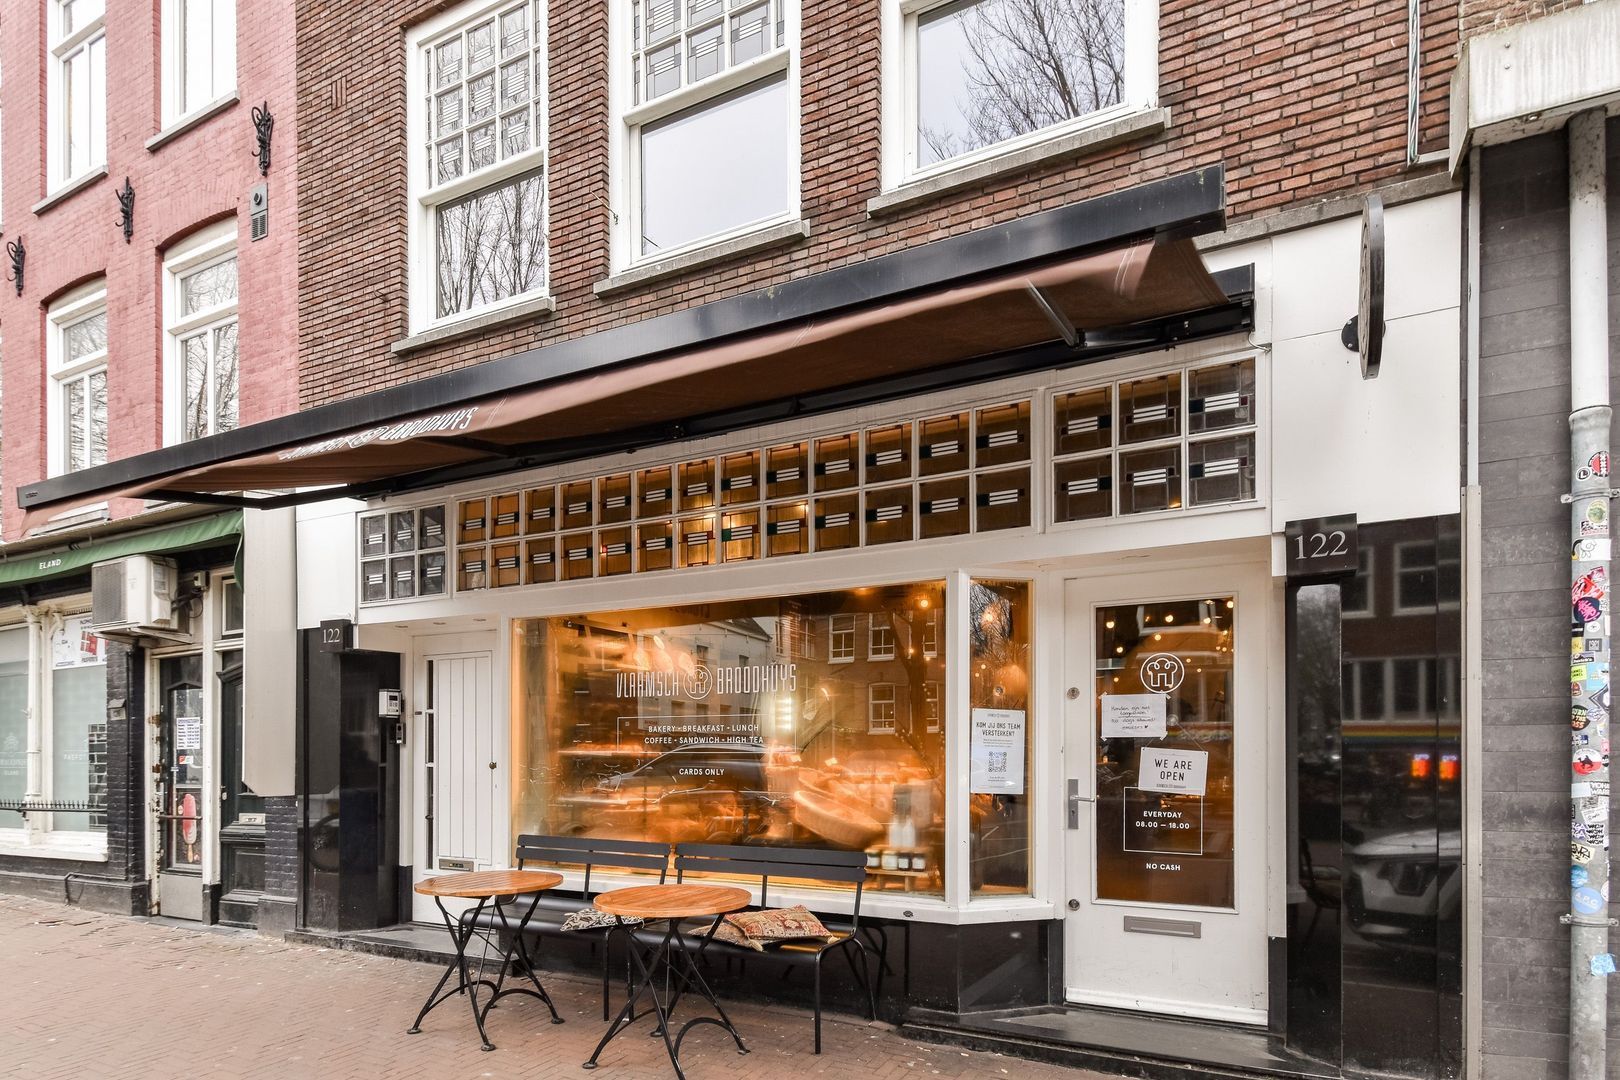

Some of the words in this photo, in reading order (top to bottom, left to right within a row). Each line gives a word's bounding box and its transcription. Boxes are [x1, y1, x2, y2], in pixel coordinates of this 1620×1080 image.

[1294, 530, 1349, 560] 122
[39, 558, 62, 570] ELAND
[323, 628, 340, 643] 122
[616, 671, 680, 699] VLAAMSCH
[717, 664, 797, 695] BROODHUYS
[648, 725, 677, 733] BAKERY
[682, 724, 725, 732] BREAKFAST
[732, 724, 760, 732] LUNCH
[982, 729, 1015, 737] VERSTERKEN?
[644, 737, 672, 745] COFFEE
[679, 736, 720, 744] SANDWICH
[727, 736, 747, 744] HIGH
[749, 736, 764, 744] TEA
[1154, 758, 1169, 769] WE
[1173, 760, 1192, 770] ARE
[679, 768, 703, 776] CARDS
[705, 768, 725, 776] ONLY
[1160, 770, 1185, 781] OPEN
[1143, 810, 1182, 818] EVERYDAY
[1146, 862, 1158, 870] NO
[1160, 863, 1181, 871] CASH
